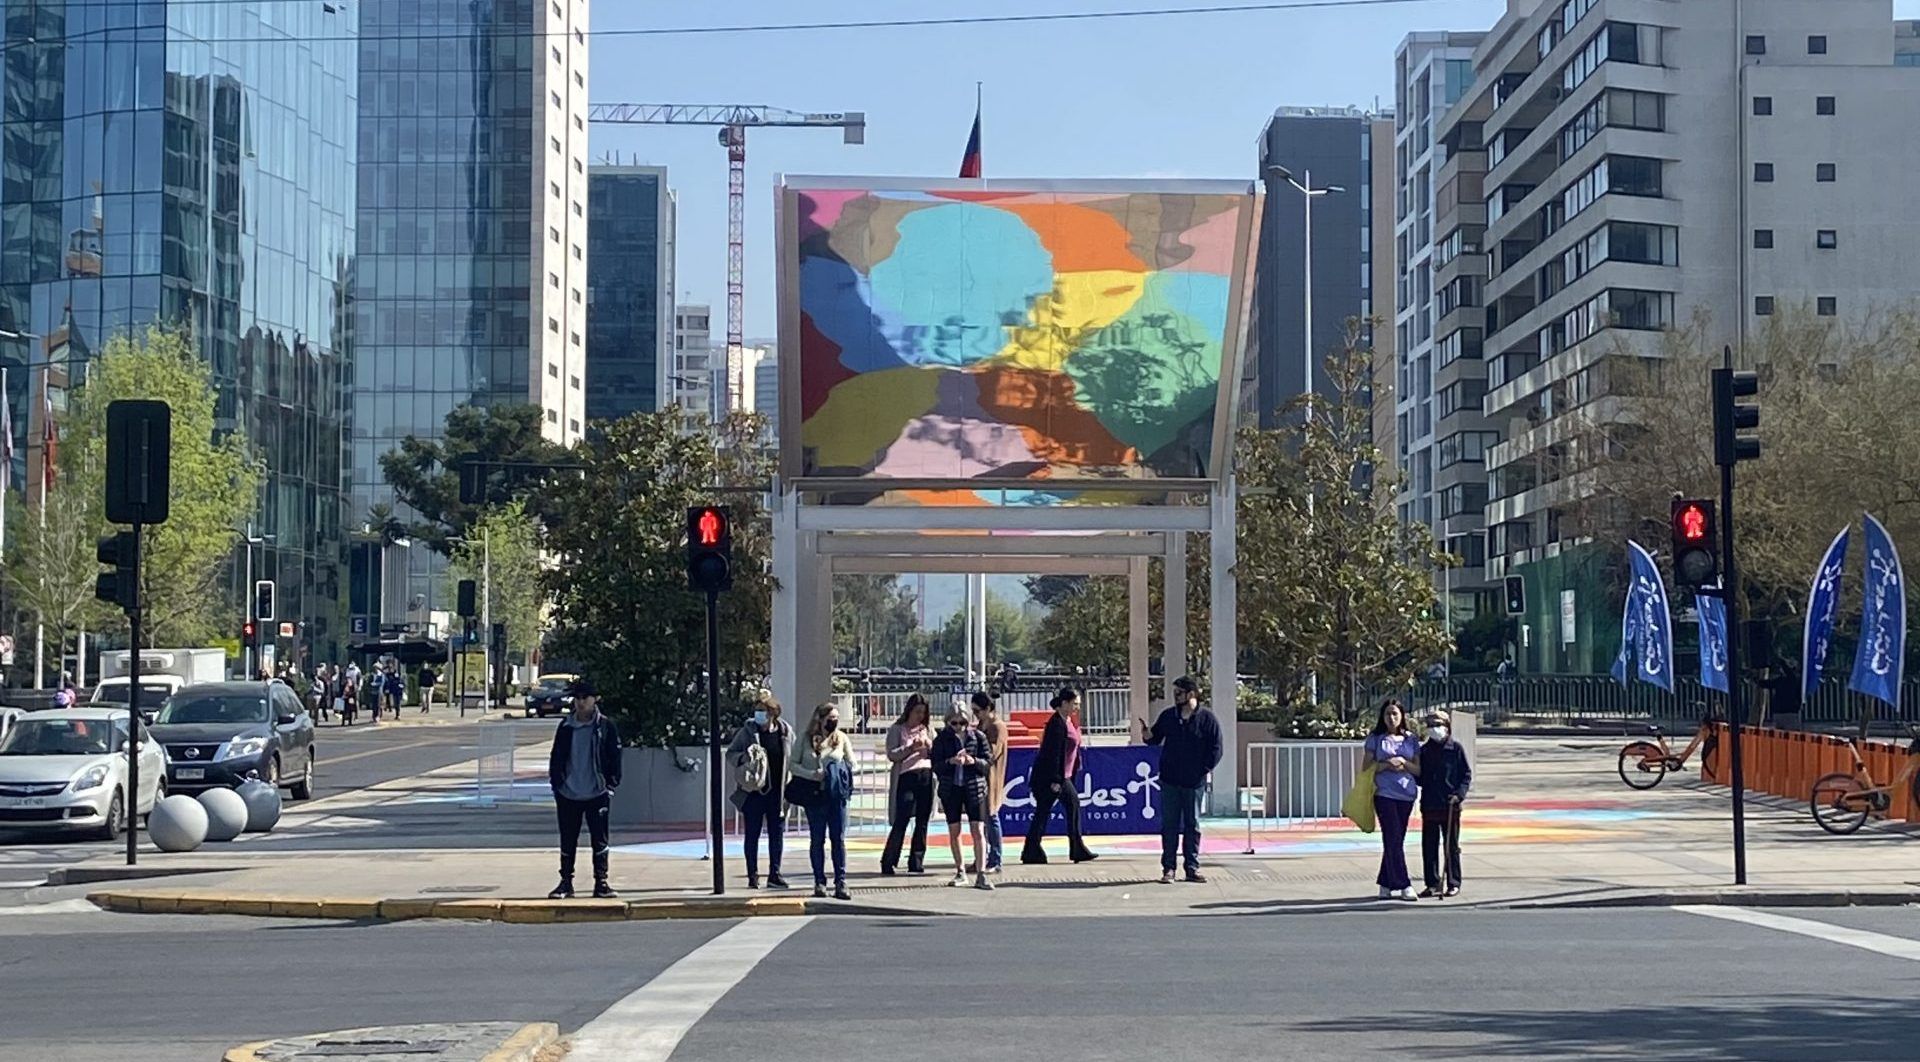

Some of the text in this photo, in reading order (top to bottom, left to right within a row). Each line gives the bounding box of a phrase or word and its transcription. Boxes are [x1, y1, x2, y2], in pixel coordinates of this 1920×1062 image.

[355, 619, 363, 632] E
[1002, 773, 1126, 807] Cdes
[1087, 811, 1126, 820] TODOS
